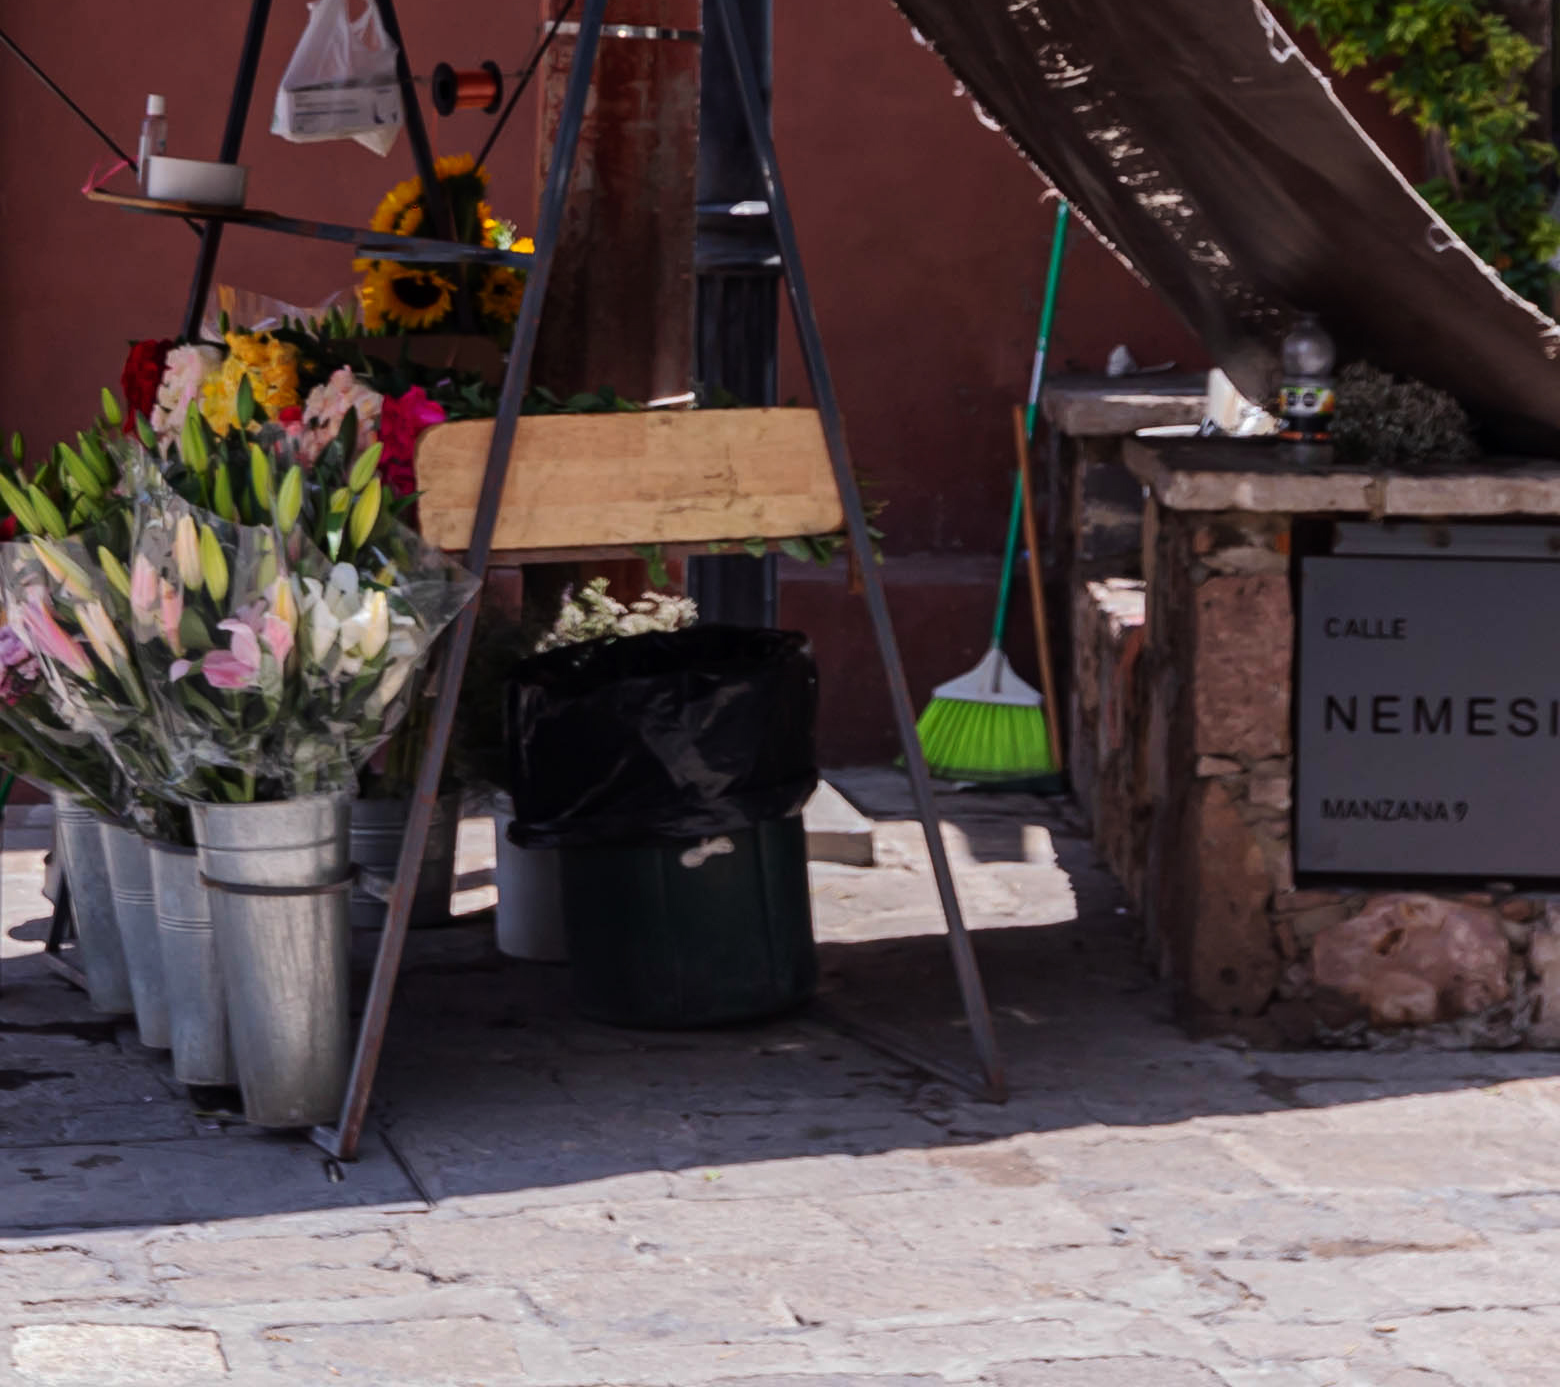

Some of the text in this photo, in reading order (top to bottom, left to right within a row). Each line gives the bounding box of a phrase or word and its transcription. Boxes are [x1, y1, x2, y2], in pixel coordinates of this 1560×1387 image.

[1324, 618, 1407, 640] CALLE
[1321, 798, 1469, 822] MANZANA 9
